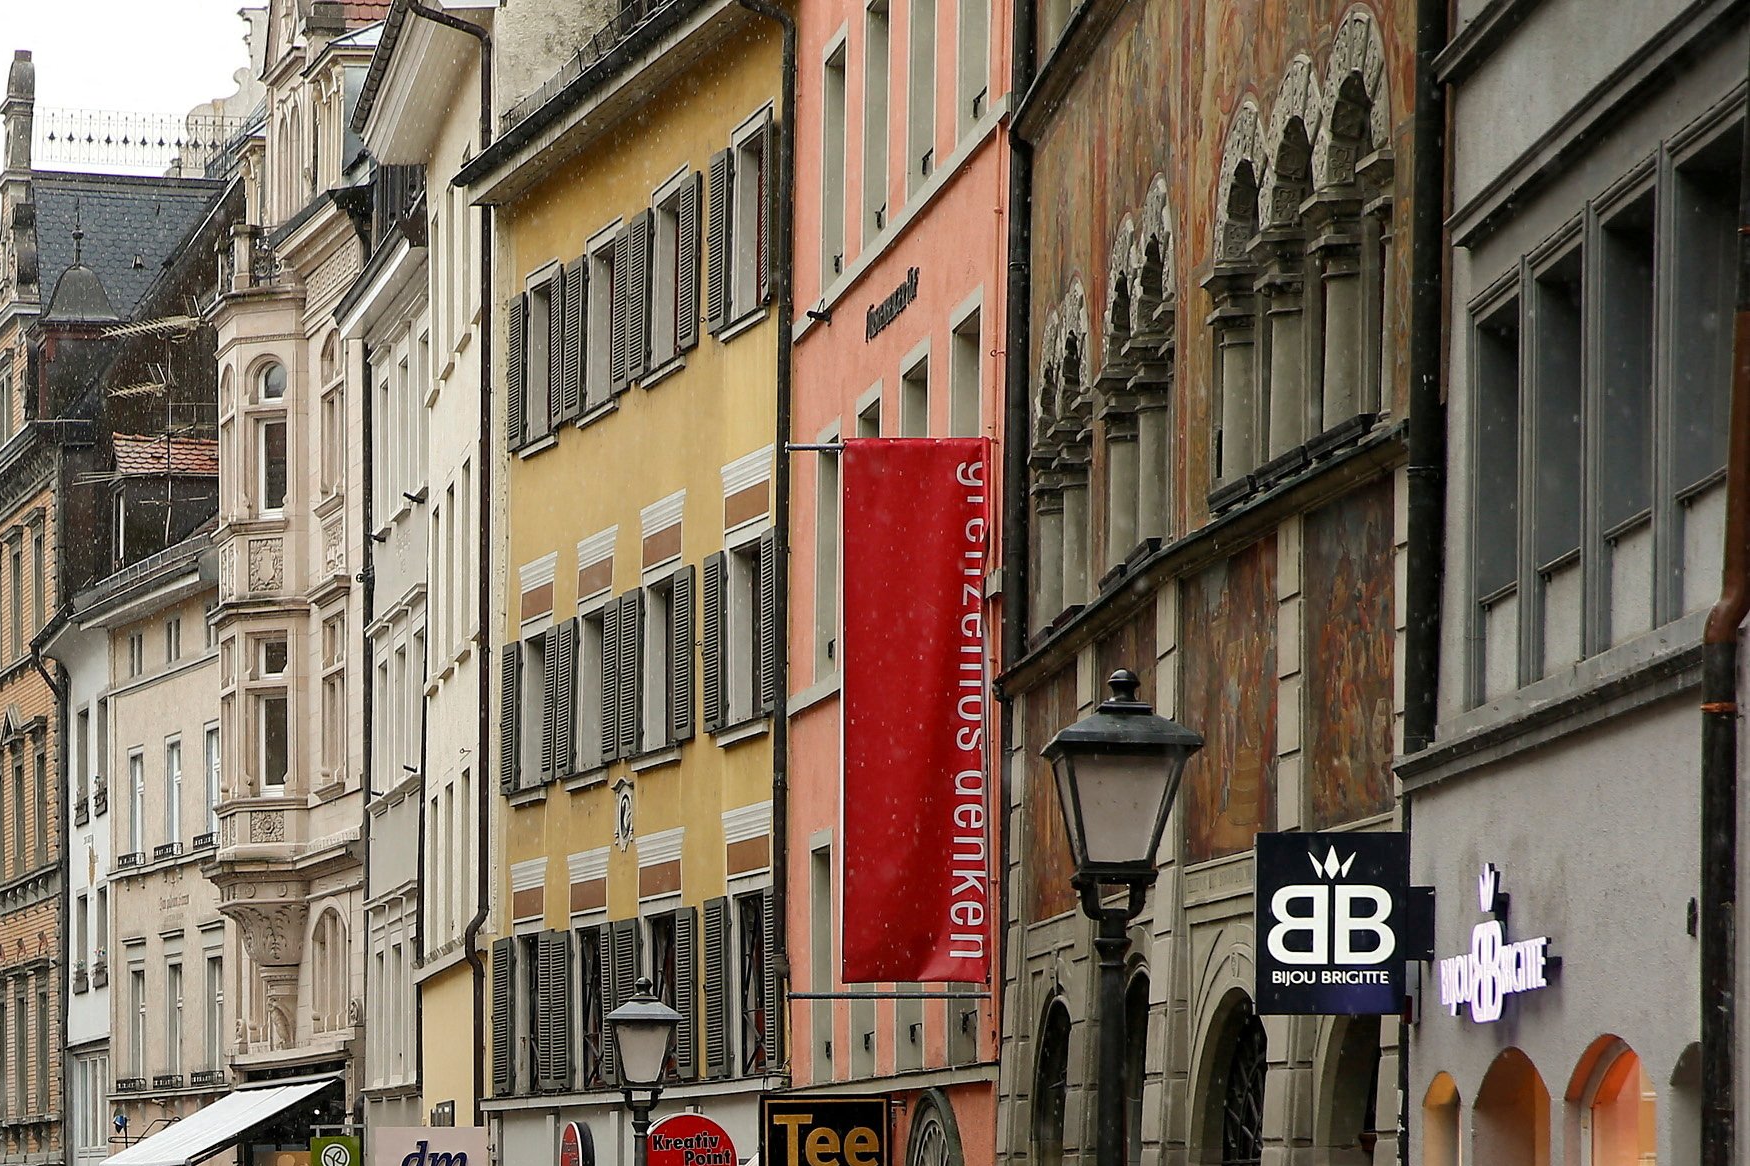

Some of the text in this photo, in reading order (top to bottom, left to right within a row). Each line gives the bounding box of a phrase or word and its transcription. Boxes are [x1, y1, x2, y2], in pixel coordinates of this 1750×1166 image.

[1271, 970, 1390, 987] BIJOU BRIGITTE
[652, 1130, 719, 1151] Kreativ
[683, 1148, 732, 1166] Point
